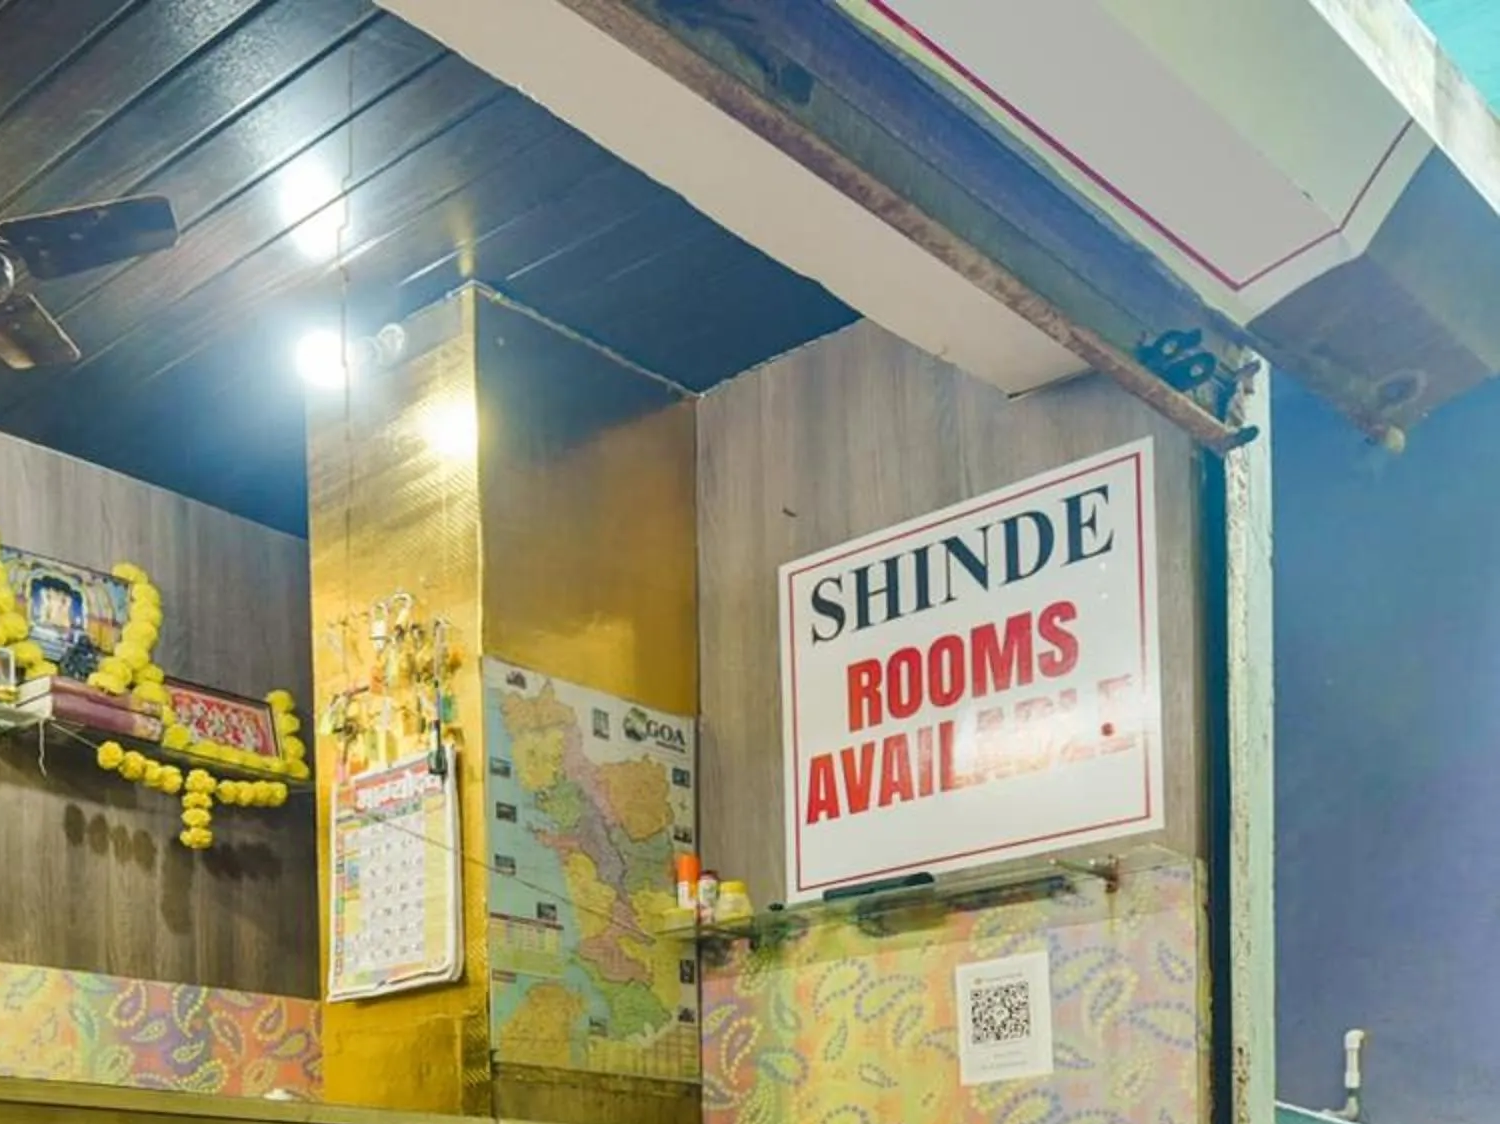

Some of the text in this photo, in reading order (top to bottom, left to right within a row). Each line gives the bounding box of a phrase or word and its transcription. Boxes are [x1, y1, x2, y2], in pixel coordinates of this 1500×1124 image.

[810, 484, 1114, 645] SHINDE
[646, 720, 686, 745] GOA
[847, 600, 1079, 733] ROOMS
[806, 674, 1136, 825] AVAIL
